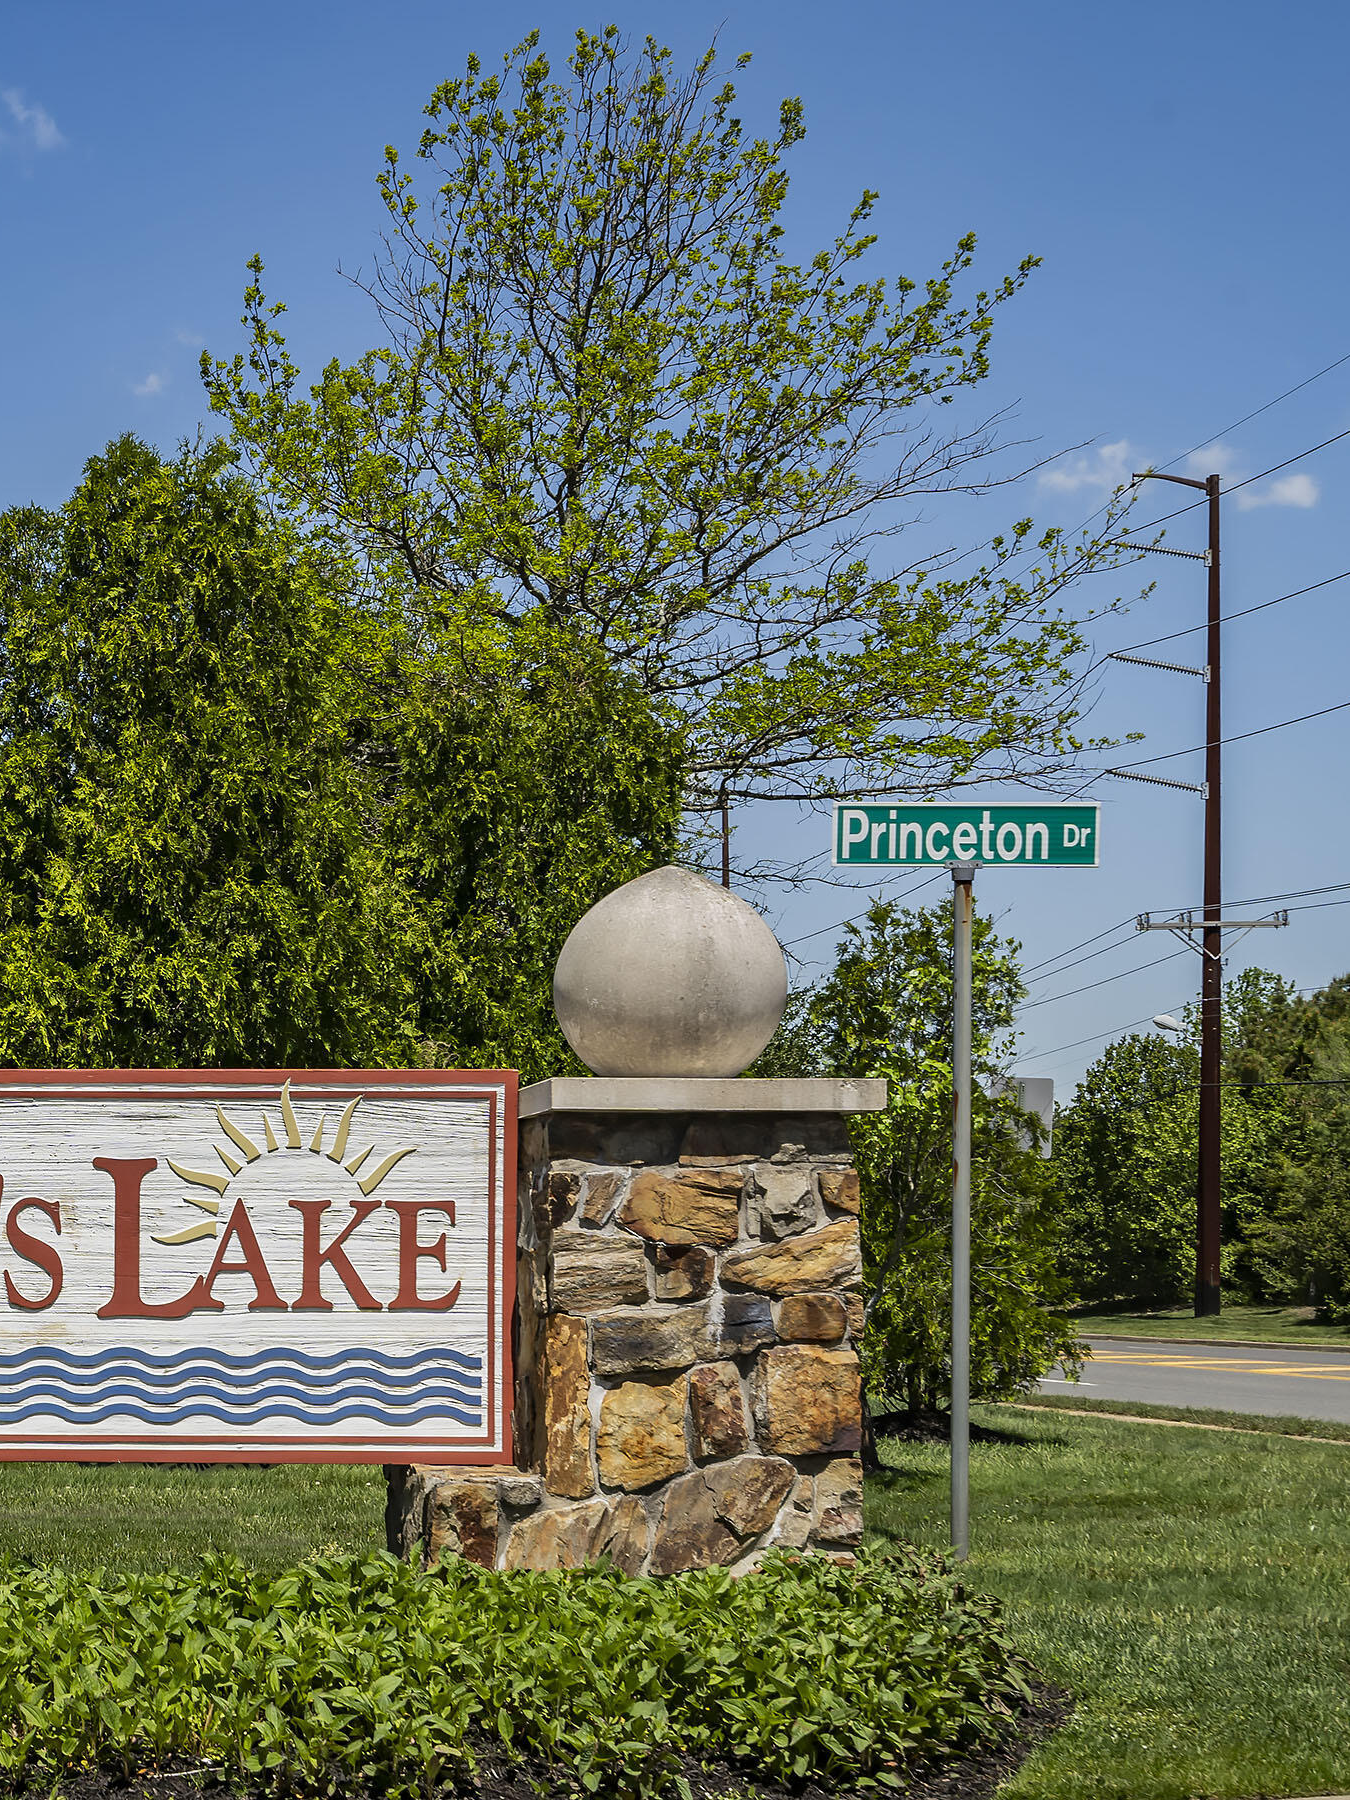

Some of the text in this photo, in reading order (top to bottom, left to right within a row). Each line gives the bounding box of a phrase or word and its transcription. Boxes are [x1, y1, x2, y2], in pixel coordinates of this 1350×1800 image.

[841, 809, 1092, 861] Princeton Dr
[92, 1157, 462, 1319] LAKE
